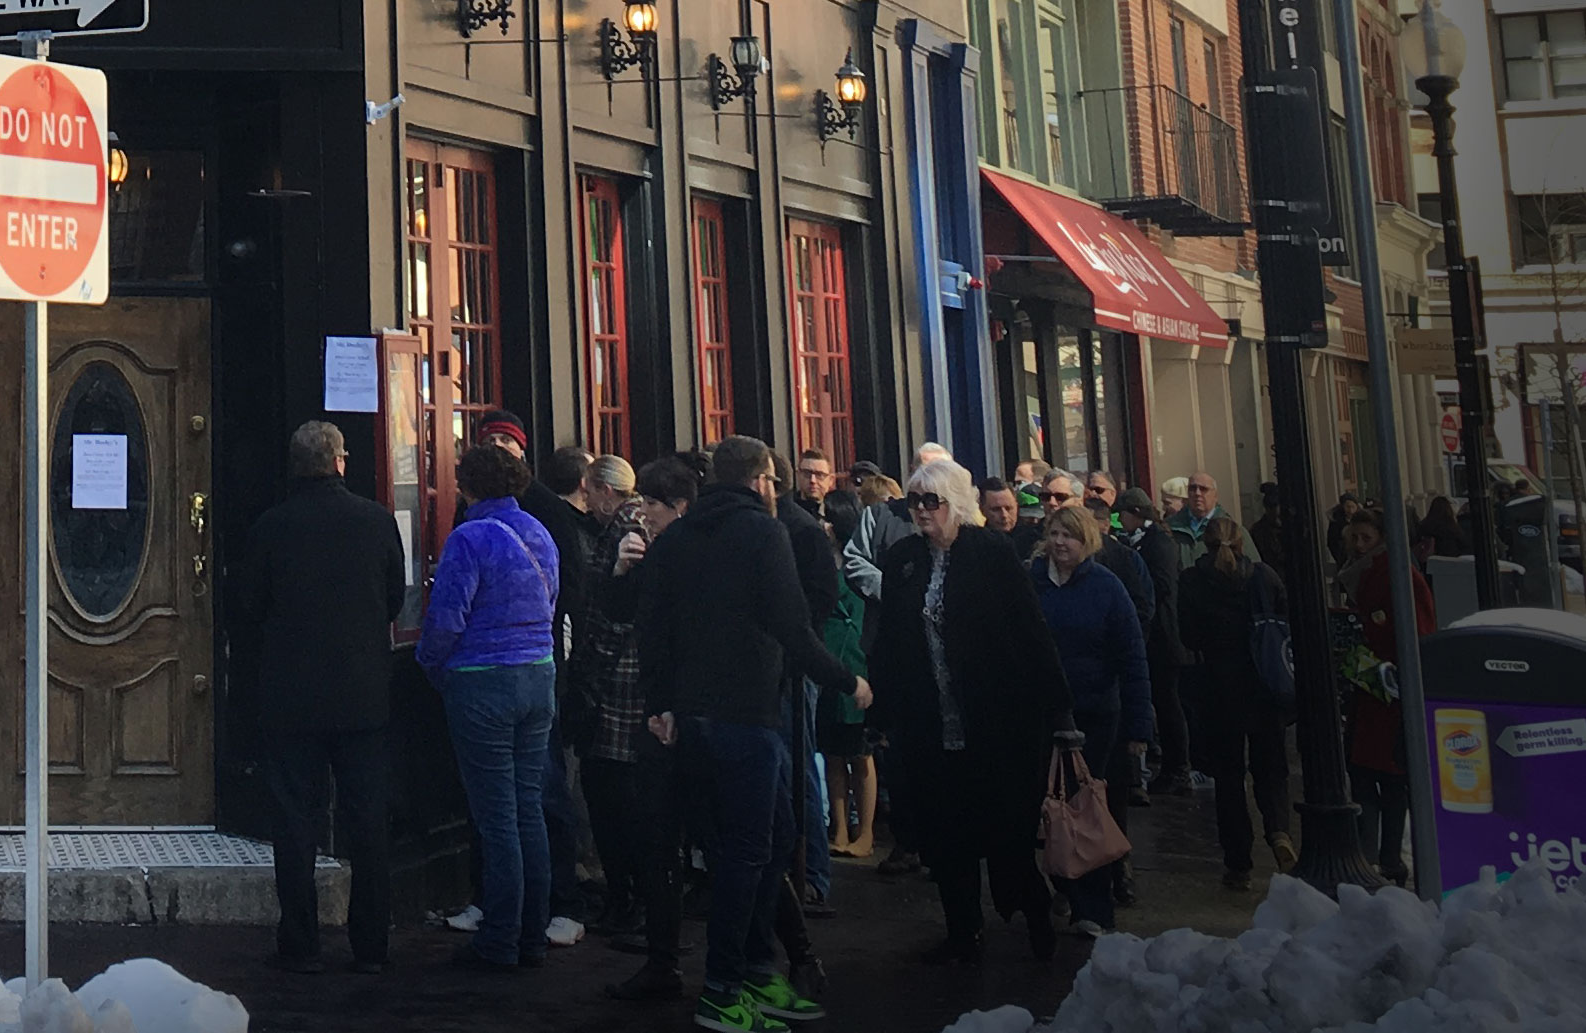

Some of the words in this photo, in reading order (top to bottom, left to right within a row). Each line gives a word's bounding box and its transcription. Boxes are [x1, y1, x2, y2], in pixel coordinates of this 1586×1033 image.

[0, 105, 30, 142] DO
[41, 110, 88, 150] NOT
[7, 212, 78, 252] ENTER
[1514, 727, 1574, 740] Relentless
[1516, 741, 1546, 752] germ
